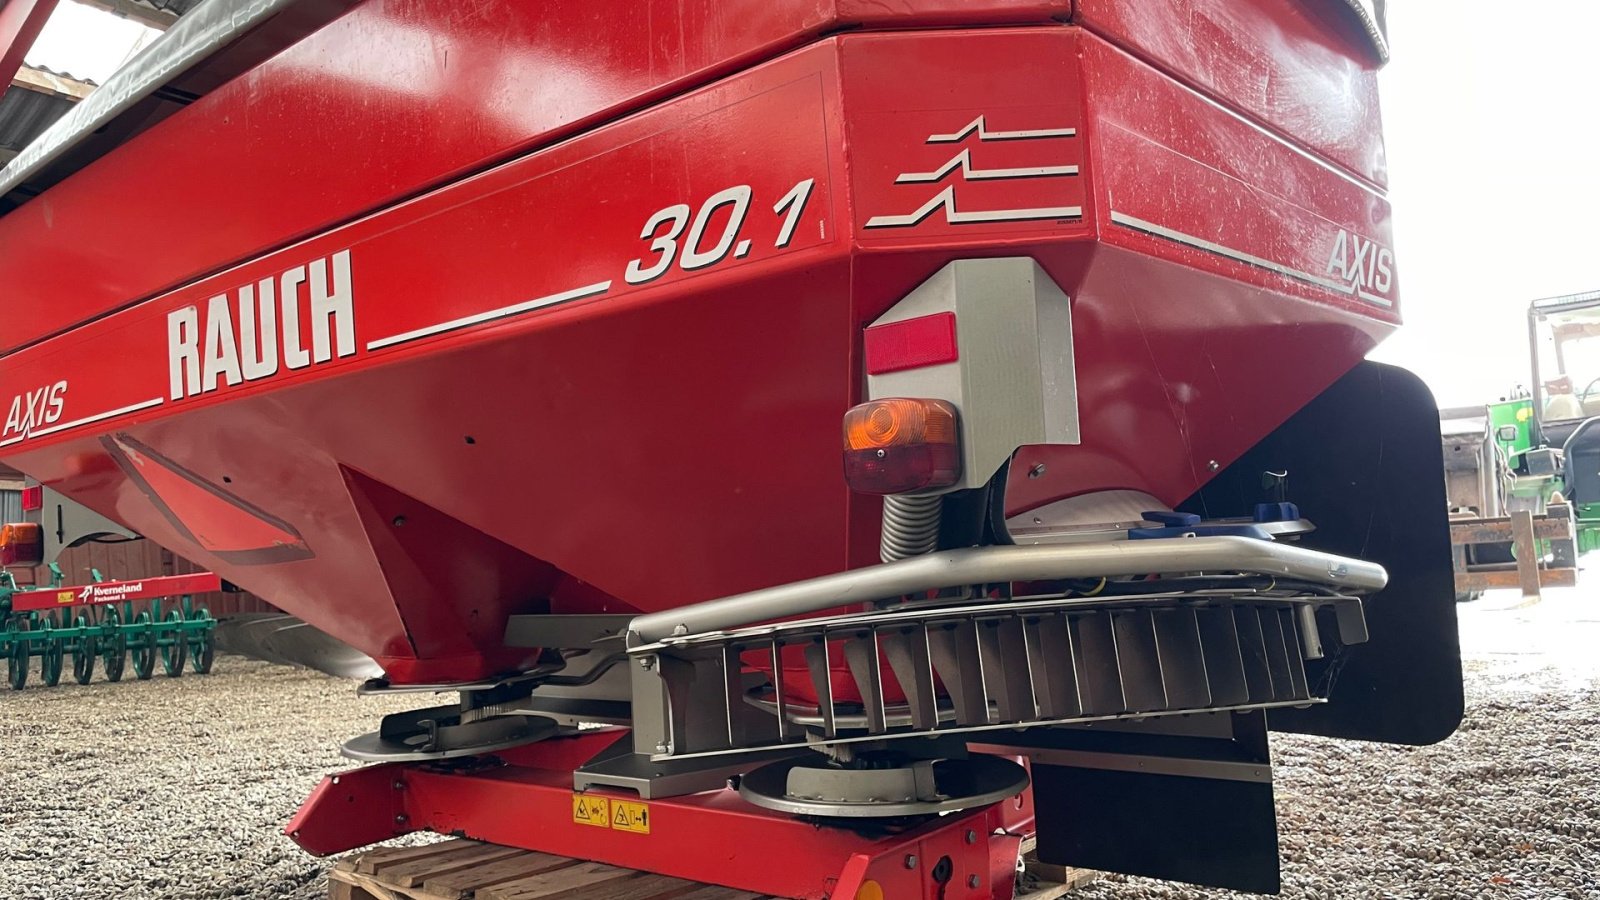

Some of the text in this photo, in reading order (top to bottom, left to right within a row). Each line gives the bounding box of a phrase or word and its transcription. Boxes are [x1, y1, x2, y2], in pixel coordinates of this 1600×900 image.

[624, 178, 815, 285] 30.1
[1326, 228, 1393, 293] AXIS
[167, 248, 356, 401] RAUCH
[2, 380, 68, 437] AXIS
[94, 582, 143, 596] Kverneland
